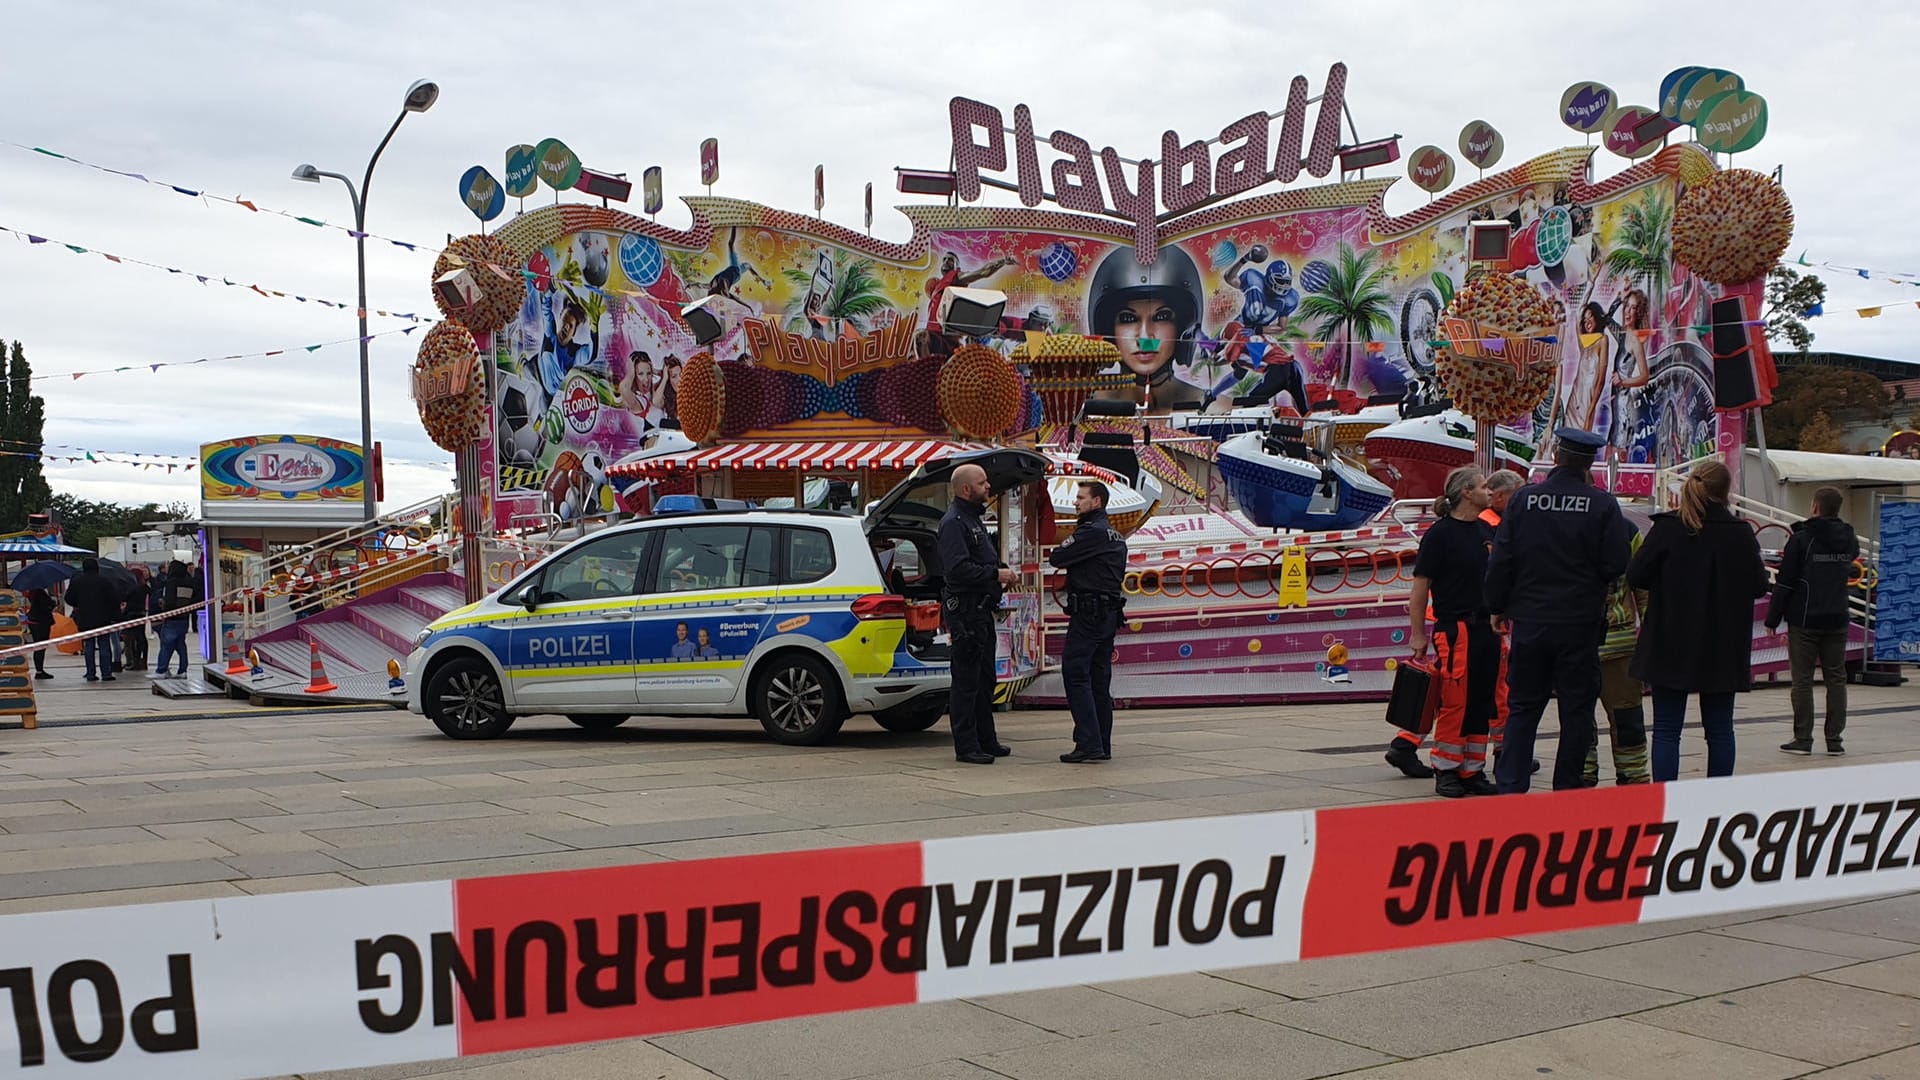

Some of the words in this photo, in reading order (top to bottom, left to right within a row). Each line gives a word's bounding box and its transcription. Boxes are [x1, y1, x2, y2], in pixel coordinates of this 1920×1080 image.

[1568, 94, 1609, 117] Playball
[1704, 106, 1761, 134] Playball
[1611, 131, 1635, 143] Play
[949, 62, 1347, 265] Playball
[743, 310, 919, 388] Playball
[563, 395, 599, 416] FLORIDA
[1527, 493, 1591, 513] POLIZEI
[398, 508, 430, 522] Eingang
[529, 635, 611, 658] POLIZEI
[1385, 798, 1920, 926] ZEIABSPERRUNG
[355, 855, 1286, 1034] POLIZEIABSPERRUNG
